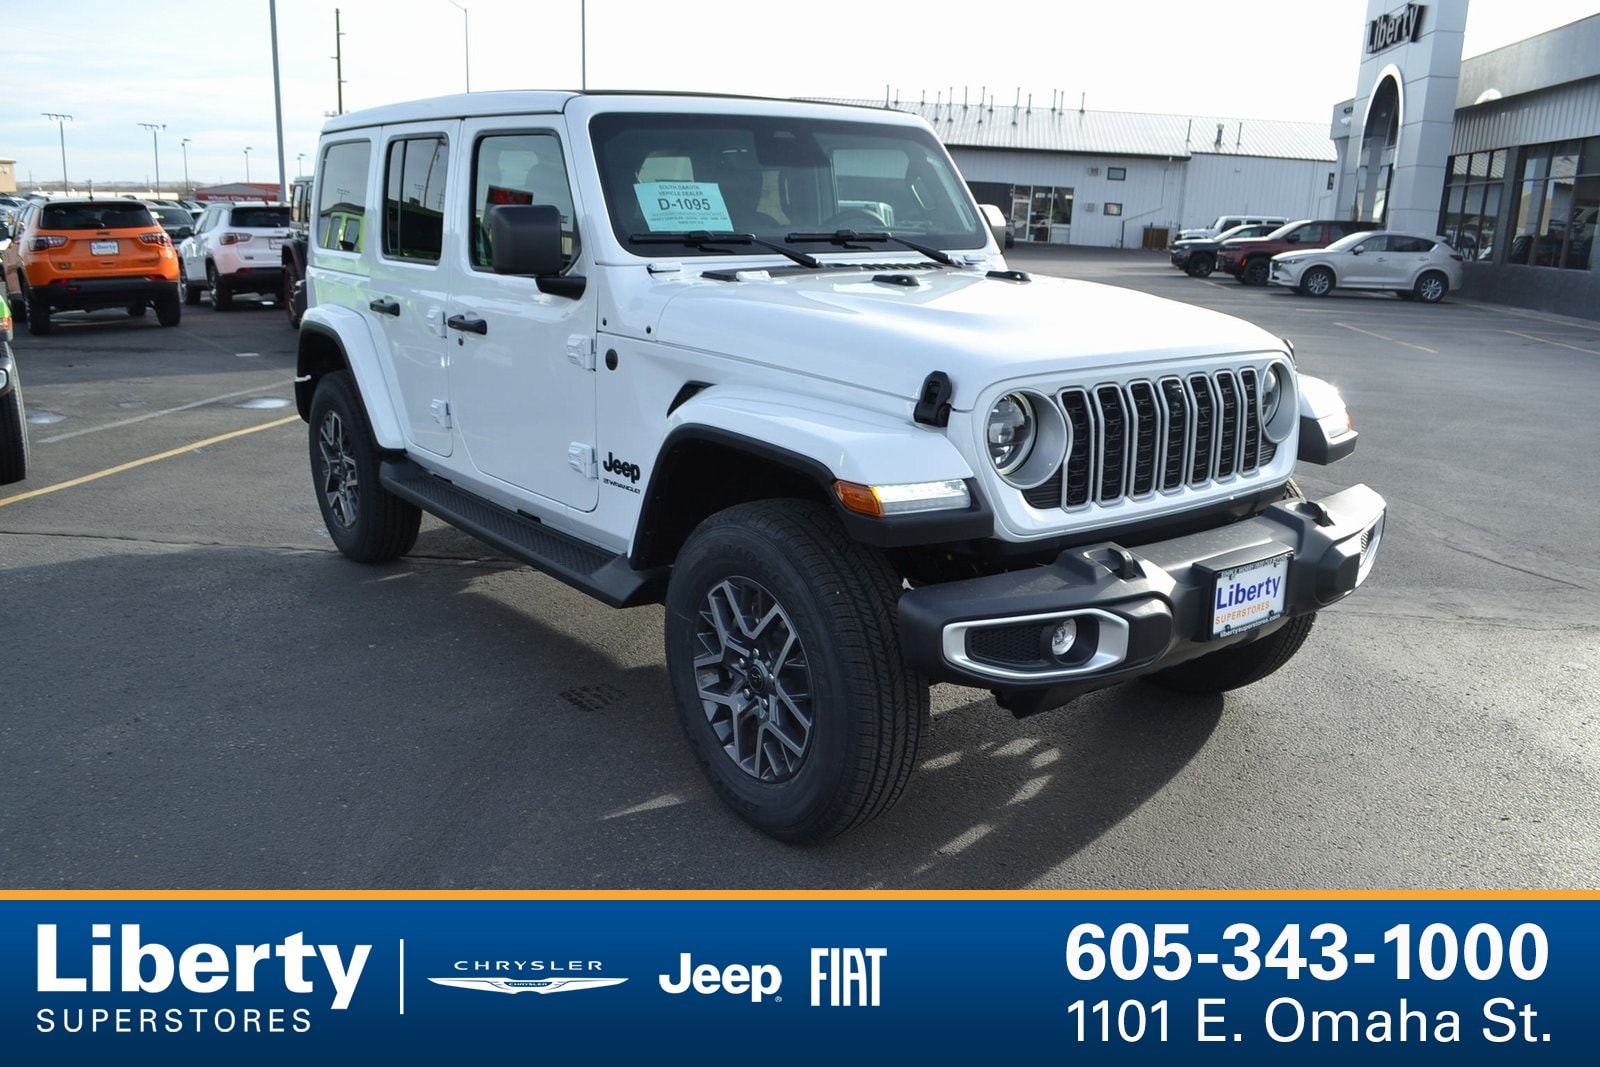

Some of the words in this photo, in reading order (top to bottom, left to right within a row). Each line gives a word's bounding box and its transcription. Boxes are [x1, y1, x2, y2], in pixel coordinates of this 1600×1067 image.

[1366, 3, 1425, 53] Liberty
[657, 198, 711, 211] D-1095
[92, 241, 116, 251] Liberty
[603, 451, 640, 484] Jeep
[1216, 576, 1281, 610] Liberty
[1215, 600, 1271, 625] SUPERSTORES
[1220, 614, 1281, 638] libertysuperstores.com
